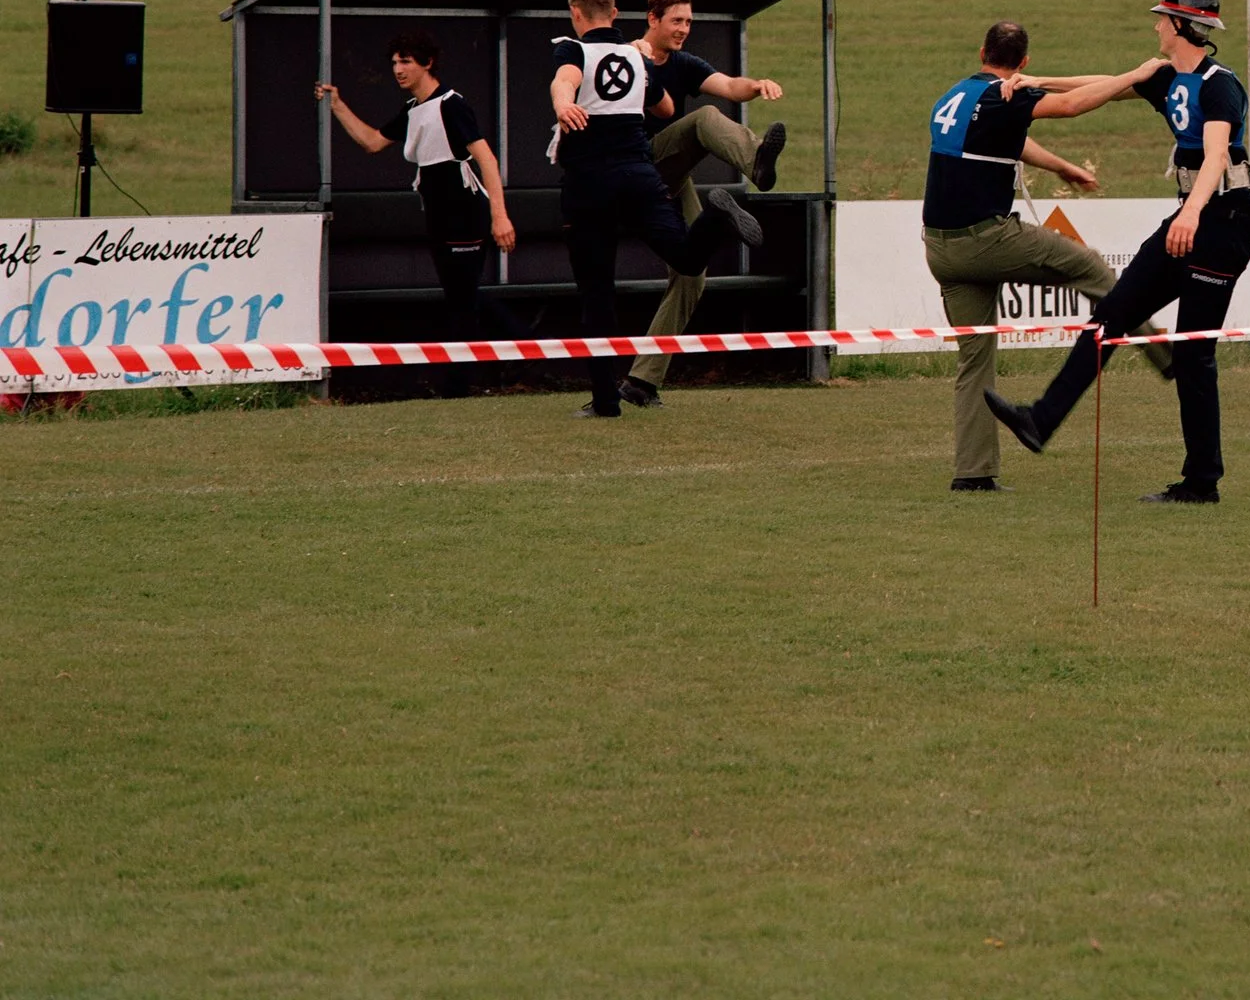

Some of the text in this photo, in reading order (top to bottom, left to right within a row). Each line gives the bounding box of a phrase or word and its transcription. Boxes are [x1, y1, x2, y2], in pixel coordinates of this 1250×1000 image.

[933, 91, 966, 135] 4
[1171, 84, 1190, 132] 3
[74, 227, 264, 266] Lebensmittel
[0, 262, 284, 385] dorfer
